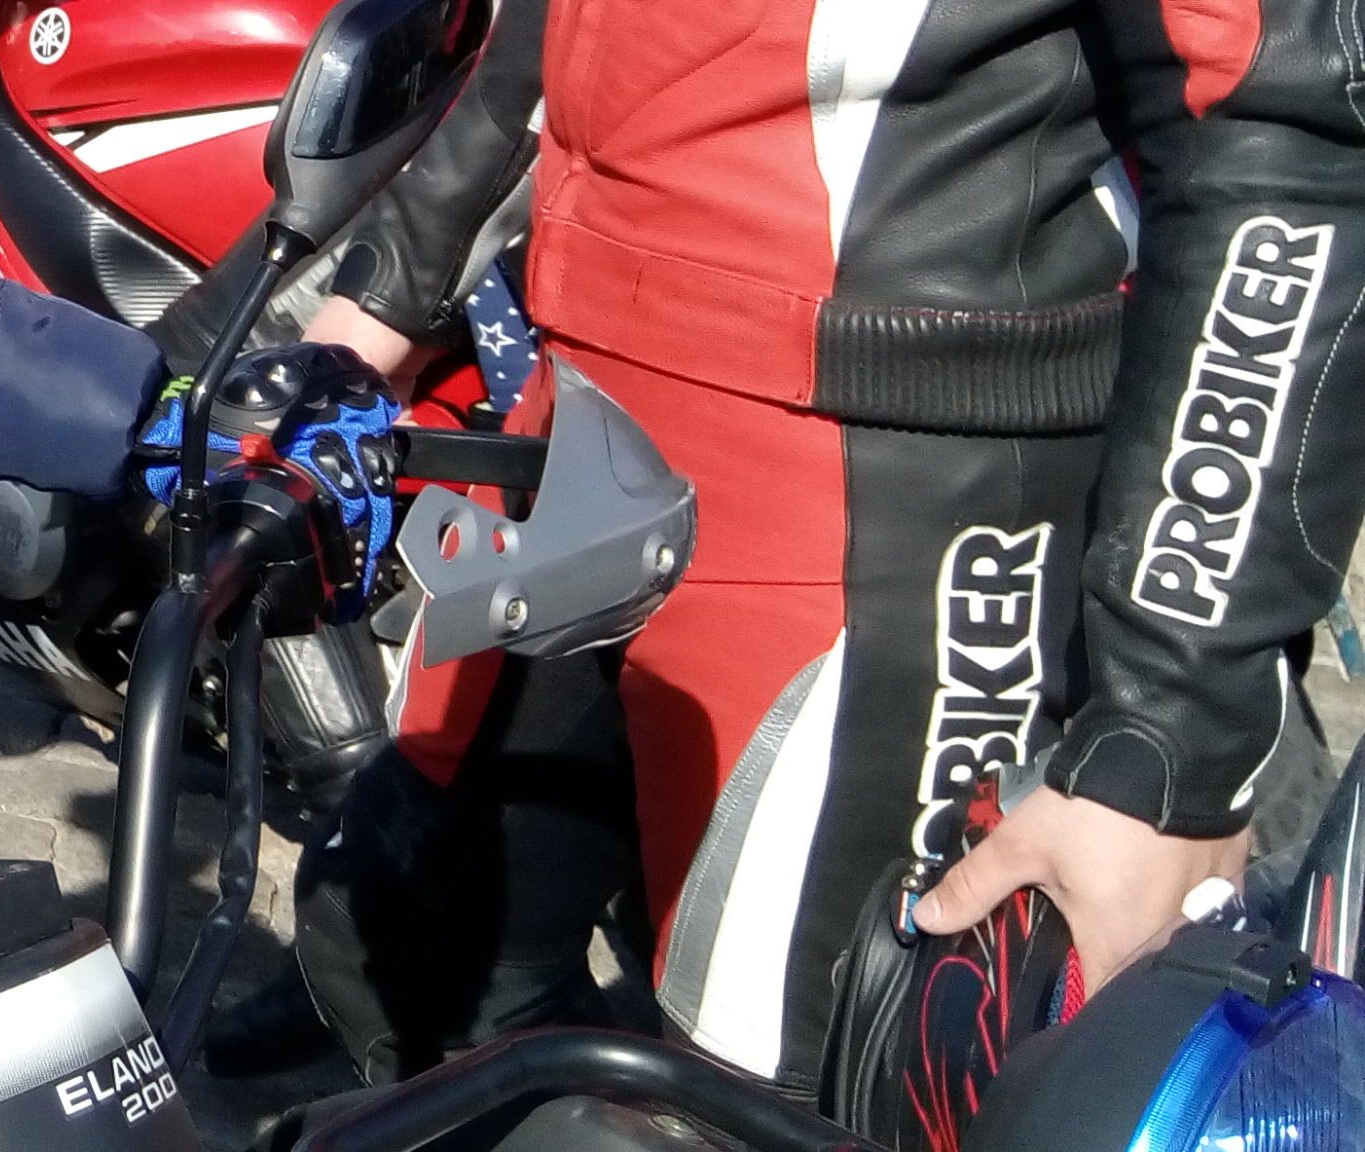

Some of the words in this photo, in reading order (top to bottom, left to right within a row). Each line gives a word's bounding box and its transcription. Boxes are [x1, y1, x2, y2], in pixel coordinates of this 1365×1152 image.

[1135, 218, 1331, 625] PROBIKER
[55, 1035, 166, 1116] ELAND
[121, 1071, 177, 1123] 200
